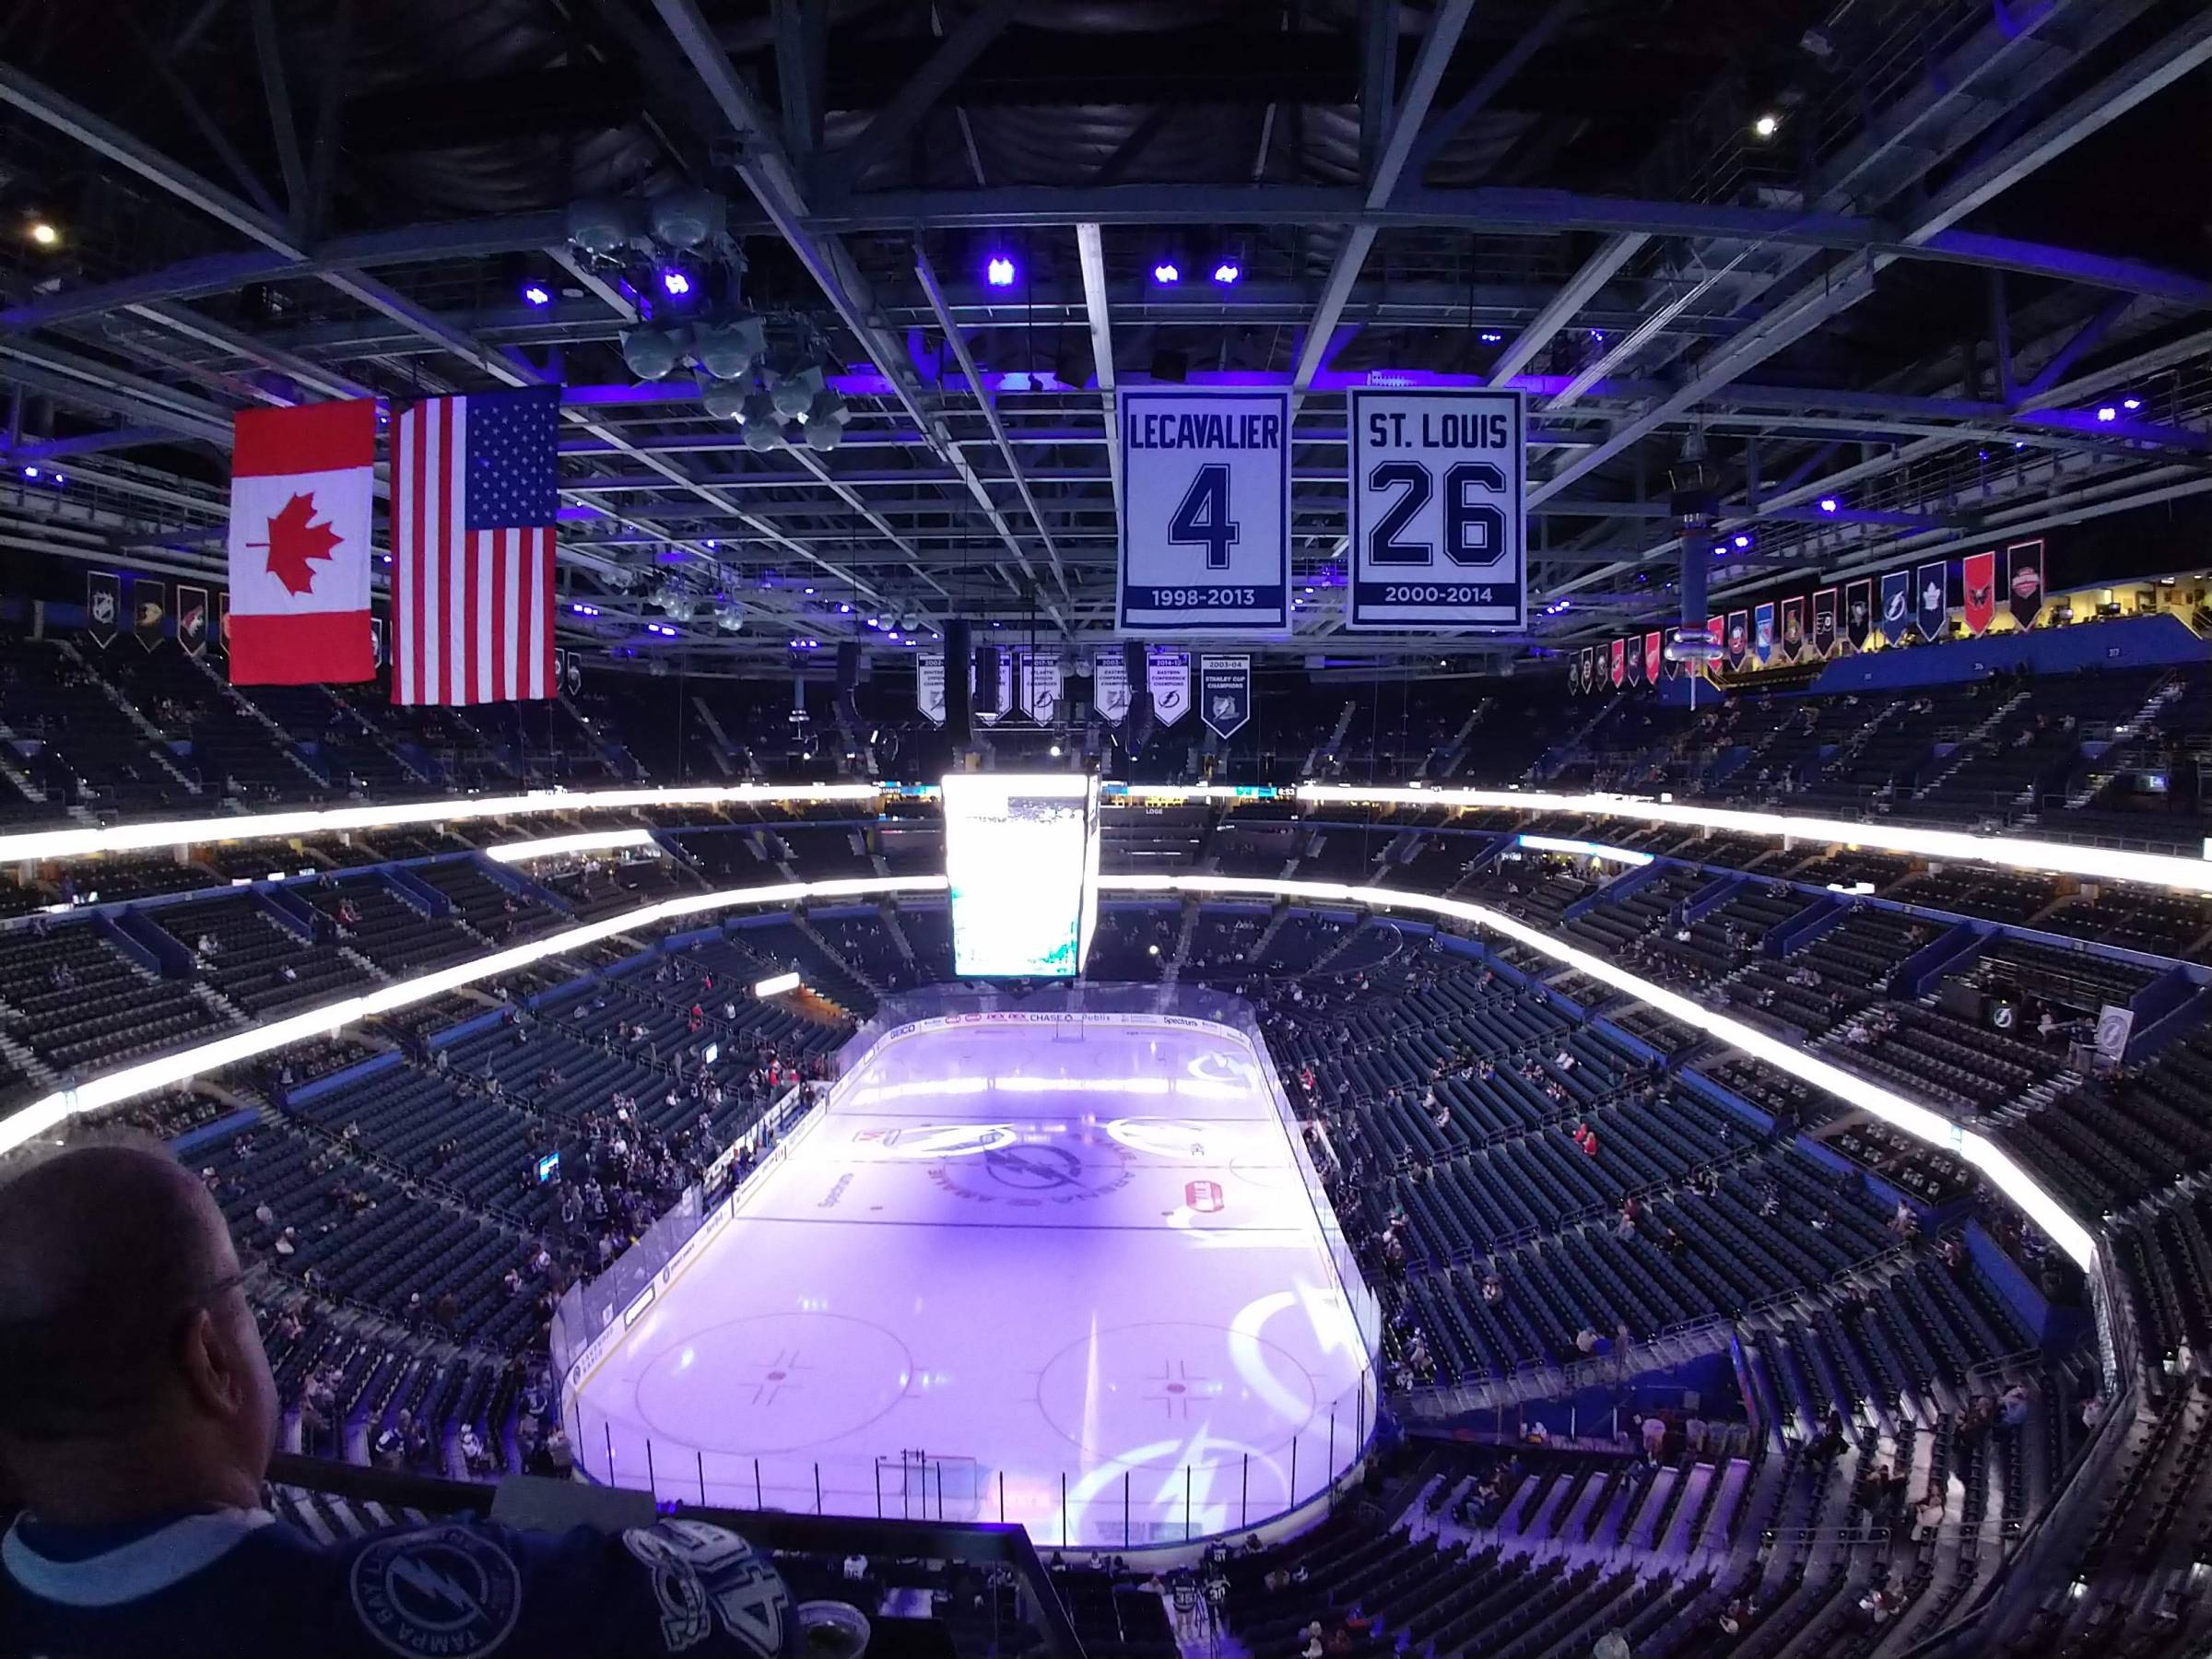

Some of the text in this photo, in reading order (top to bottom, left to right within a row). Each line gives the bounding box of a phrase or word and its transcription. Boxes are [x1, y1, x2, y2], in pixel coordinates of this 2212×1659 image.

[1130, 413, 1279, 449] LECAVALIER
[1370, 413, 1508, 449] ST. LOUIS
[1167, 463, 1240, 570] 4
[1369, 461, 1507, 568] 26
[1151, 588, 1255, 607] 1998-2013
[1384, 586, 1494, 604] 2000-2014
[1030, 1014, 1062, 1023] CHASE
[1082, 1014, 1111, 1022] Publix
[1163, 1016, 1198, 1028] Spectrum
[890, 1024, 915, 1040] GEICO
[398, 1620, 482, 1653] TAMPA
